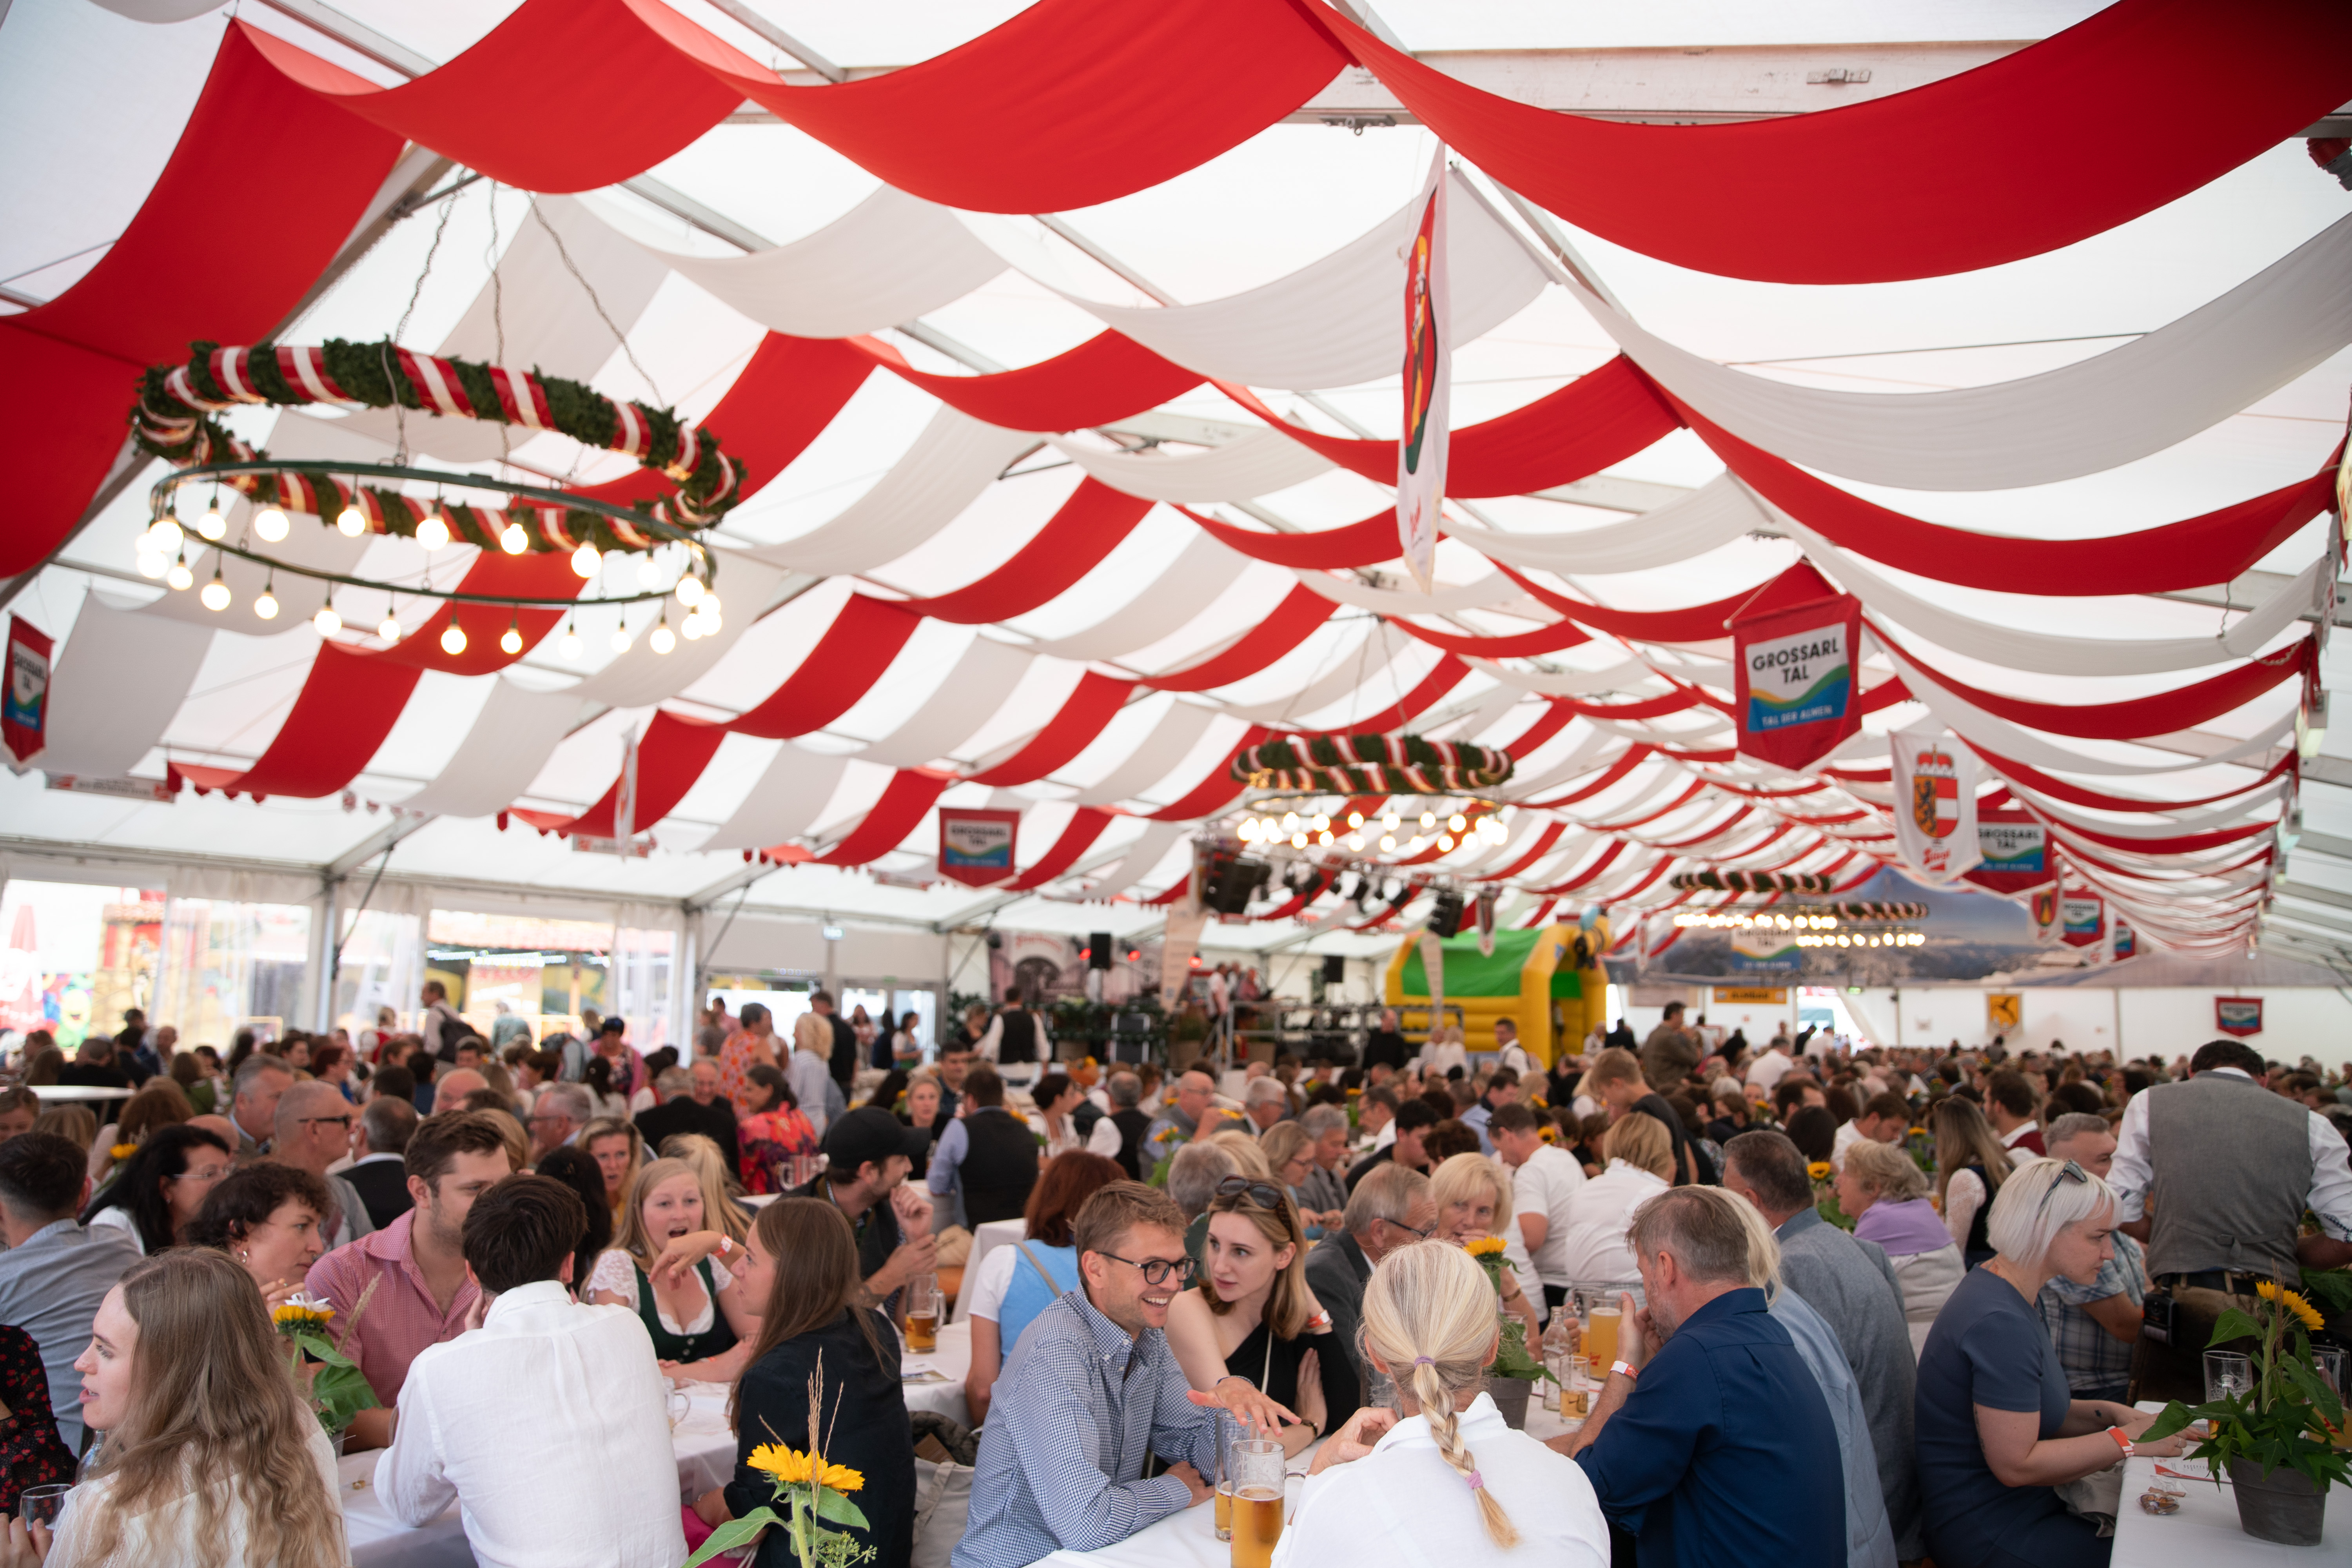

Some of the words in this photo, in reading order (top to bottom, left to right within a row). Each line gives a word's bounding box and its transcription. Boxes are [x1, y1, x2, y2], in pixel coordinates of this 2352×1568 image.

[1752, 637, 1839, 671] GROSSARL
[1782, 665, 1810, 684] TAL
[1762, 714, 1779, 726] TAL
[1781, 710, 1797, 723] DER
[1799, 705, 1833, 720] ALMEN
[1997, 838, 2016, 849] TAL
